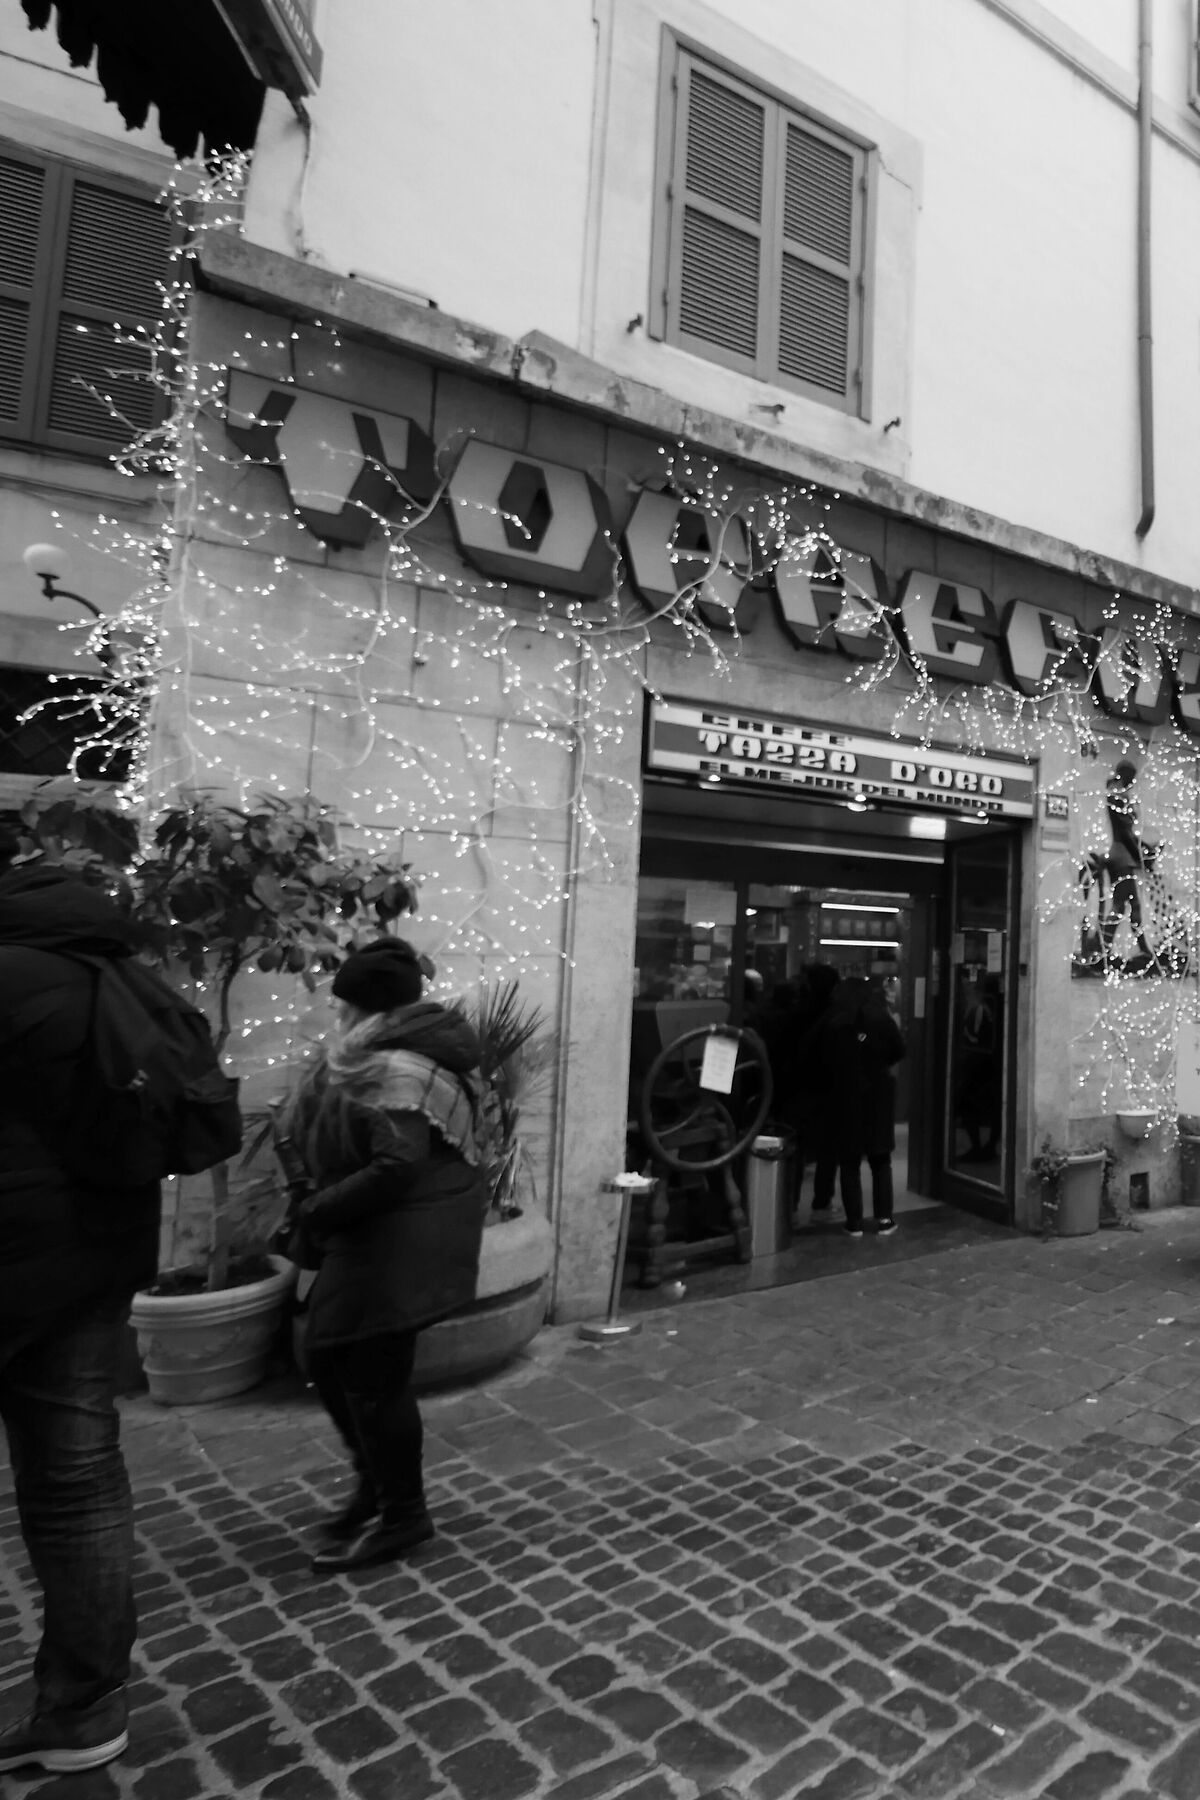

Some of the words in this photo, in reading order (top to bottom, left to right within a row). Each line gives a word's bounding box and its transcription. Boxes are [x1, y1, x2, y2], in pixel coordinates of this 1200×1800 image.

[698, 729, 857, 775] TAZZA
[890, 760, 1003, 796] D'ORO
[700, 760, 739, 777] EL
[745, 766, 855, 793] MEJOR
[861, 783, 911, 801] DEL
[917, 791, 1003, 812] MUNDO
